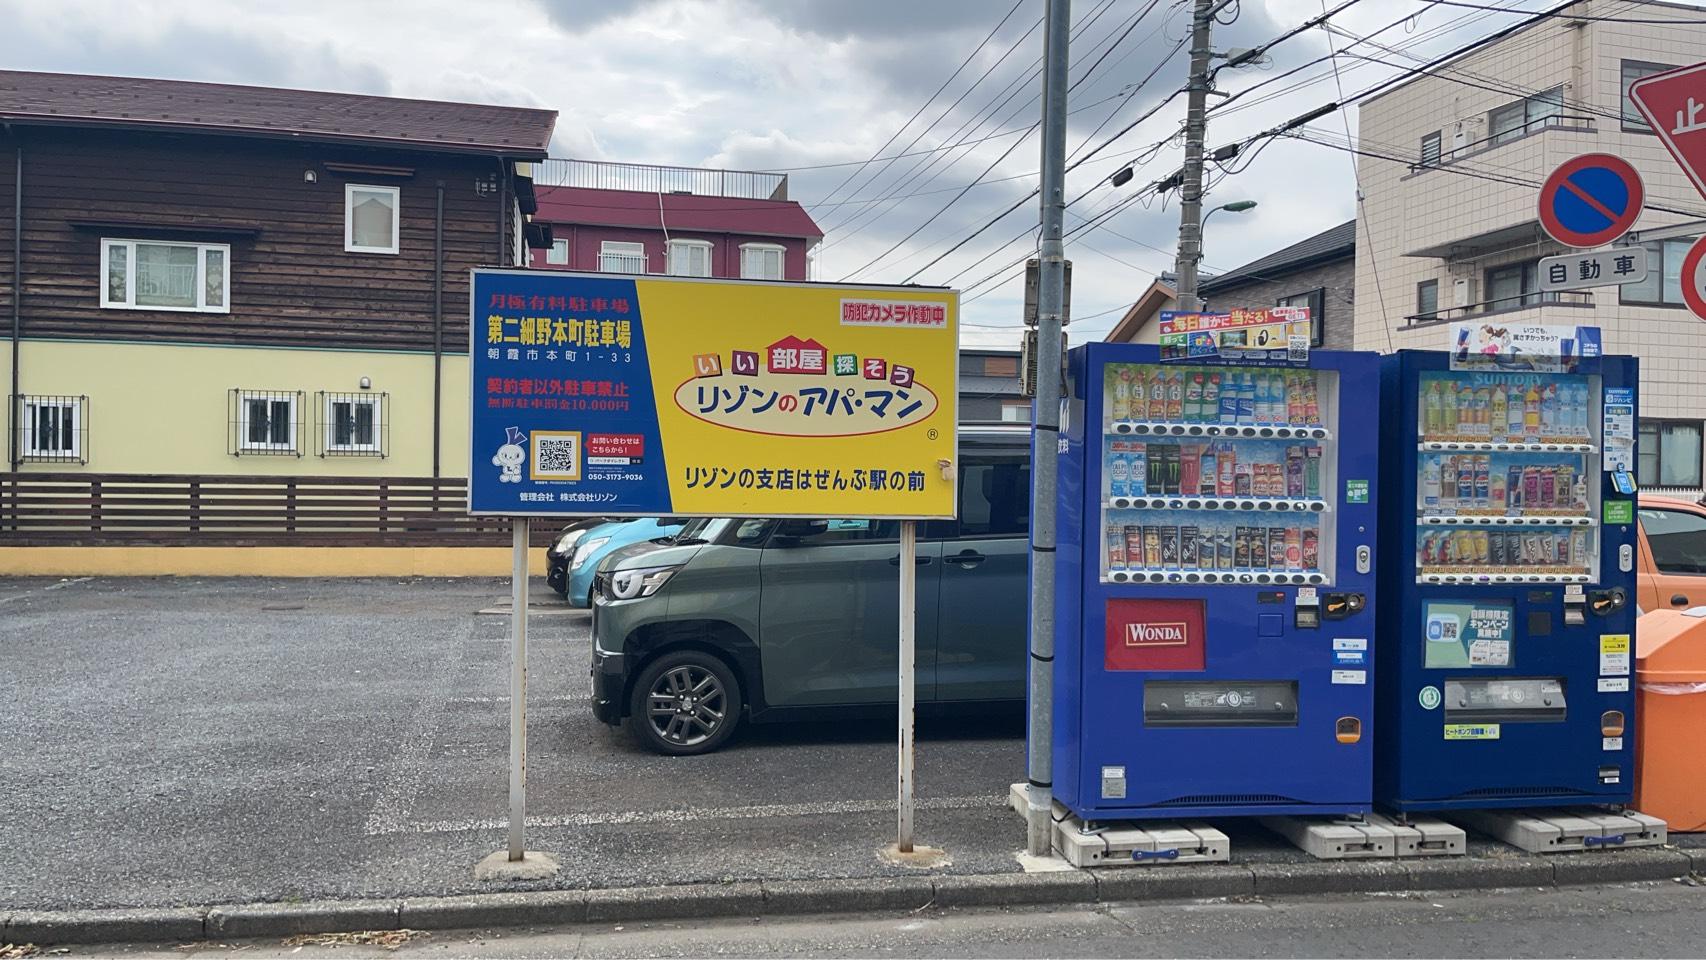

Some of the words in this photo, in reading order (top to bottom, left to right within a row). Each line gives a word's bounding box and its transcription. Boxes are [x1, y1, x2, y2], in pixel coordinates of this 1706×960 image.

[1549, 255, 1636, 284] 自動車
[488, 294, 629, 314] 月極有料駐車場
[842, 303, 944, 324] 防犯カメラ作動中
[487, 315, 632, 349] 第二細野本町駐車場
[699, 348, 911, 386] いい部屋探そう
[487, 378, 629, 397] 契約者以外駐車禁止
[697, 385, 923, 419] リゾンのアパ・マン
[592, 437, 640, 445] お問い合わせは
[588, 473, 643, 481] 050-3173-9036
[685, 467, 925, 493] リゾンの支店はぜんぶ駅の前
[519, 492, 554, 502] 管理会社
[560, 492, 618, 502] 株式会社リゾン
[1129, 623, 1183, 642] WONDA
[1470, 620, 1509, 630] キャンペーン
